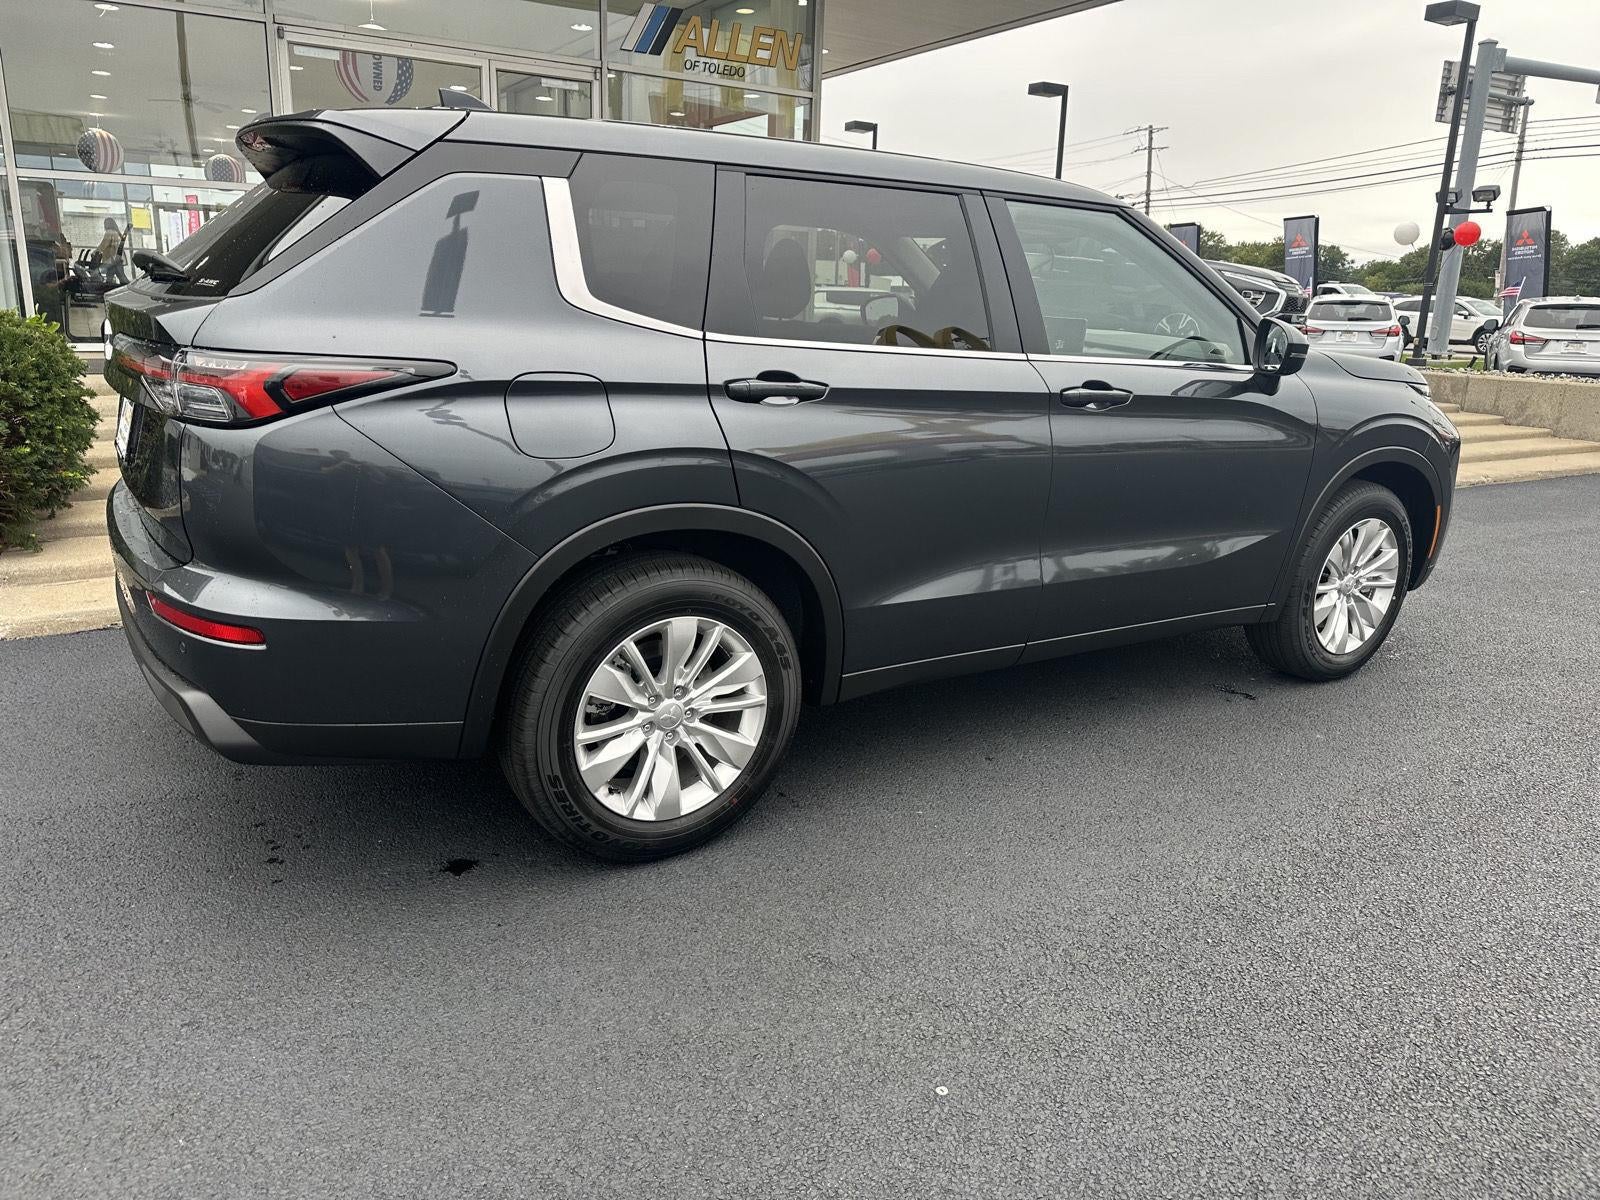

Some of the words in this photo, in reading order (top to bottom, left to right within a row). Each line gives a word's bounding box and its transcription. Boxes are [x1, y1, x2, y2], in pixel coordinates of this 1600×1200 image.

[674, 15, 803, 71] ALLEN
[684, 59, 700, 71] OF
[702, 62, 746, 79] TOLEDO
